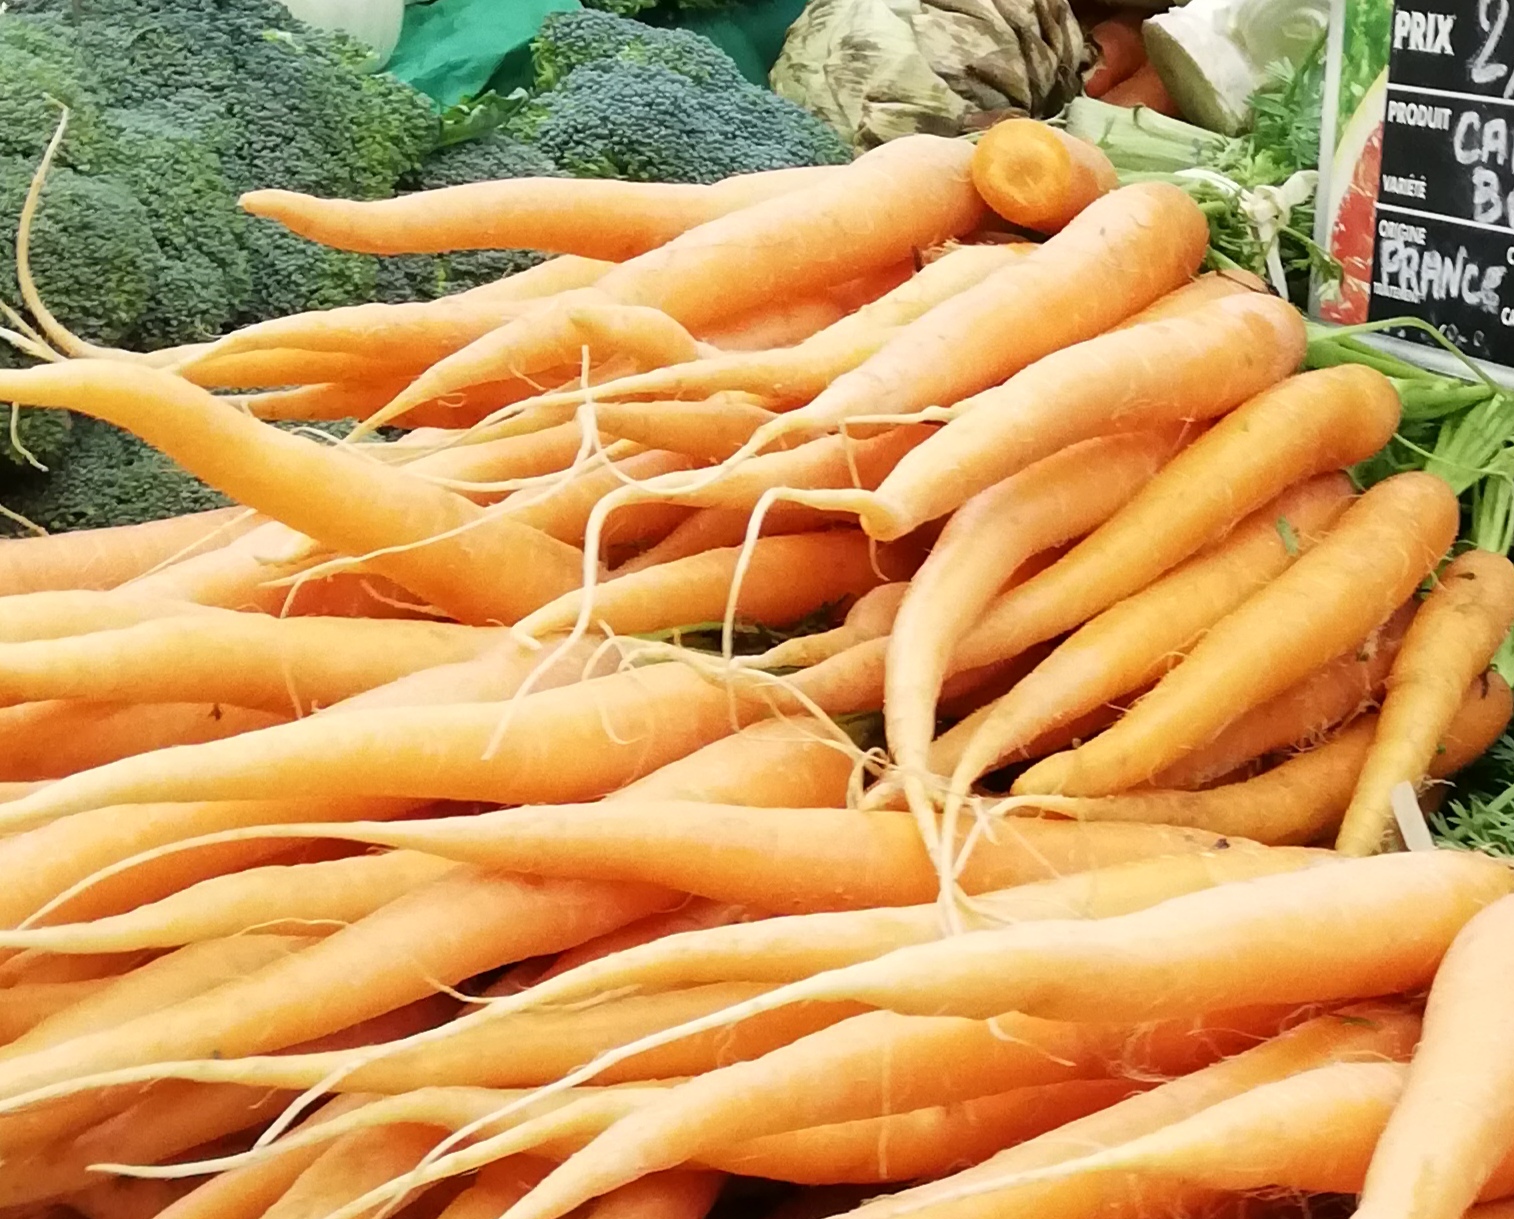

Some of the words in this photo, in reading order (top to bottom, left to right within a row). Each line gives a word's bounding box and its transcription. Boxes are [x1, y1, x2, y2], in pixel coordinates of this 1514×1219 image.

[1393, 9, 1456, 56] PRIX
[1388, 101, 1452, 131] PRODUIT
[1378, 220, 1427, 245] ORIGINE
